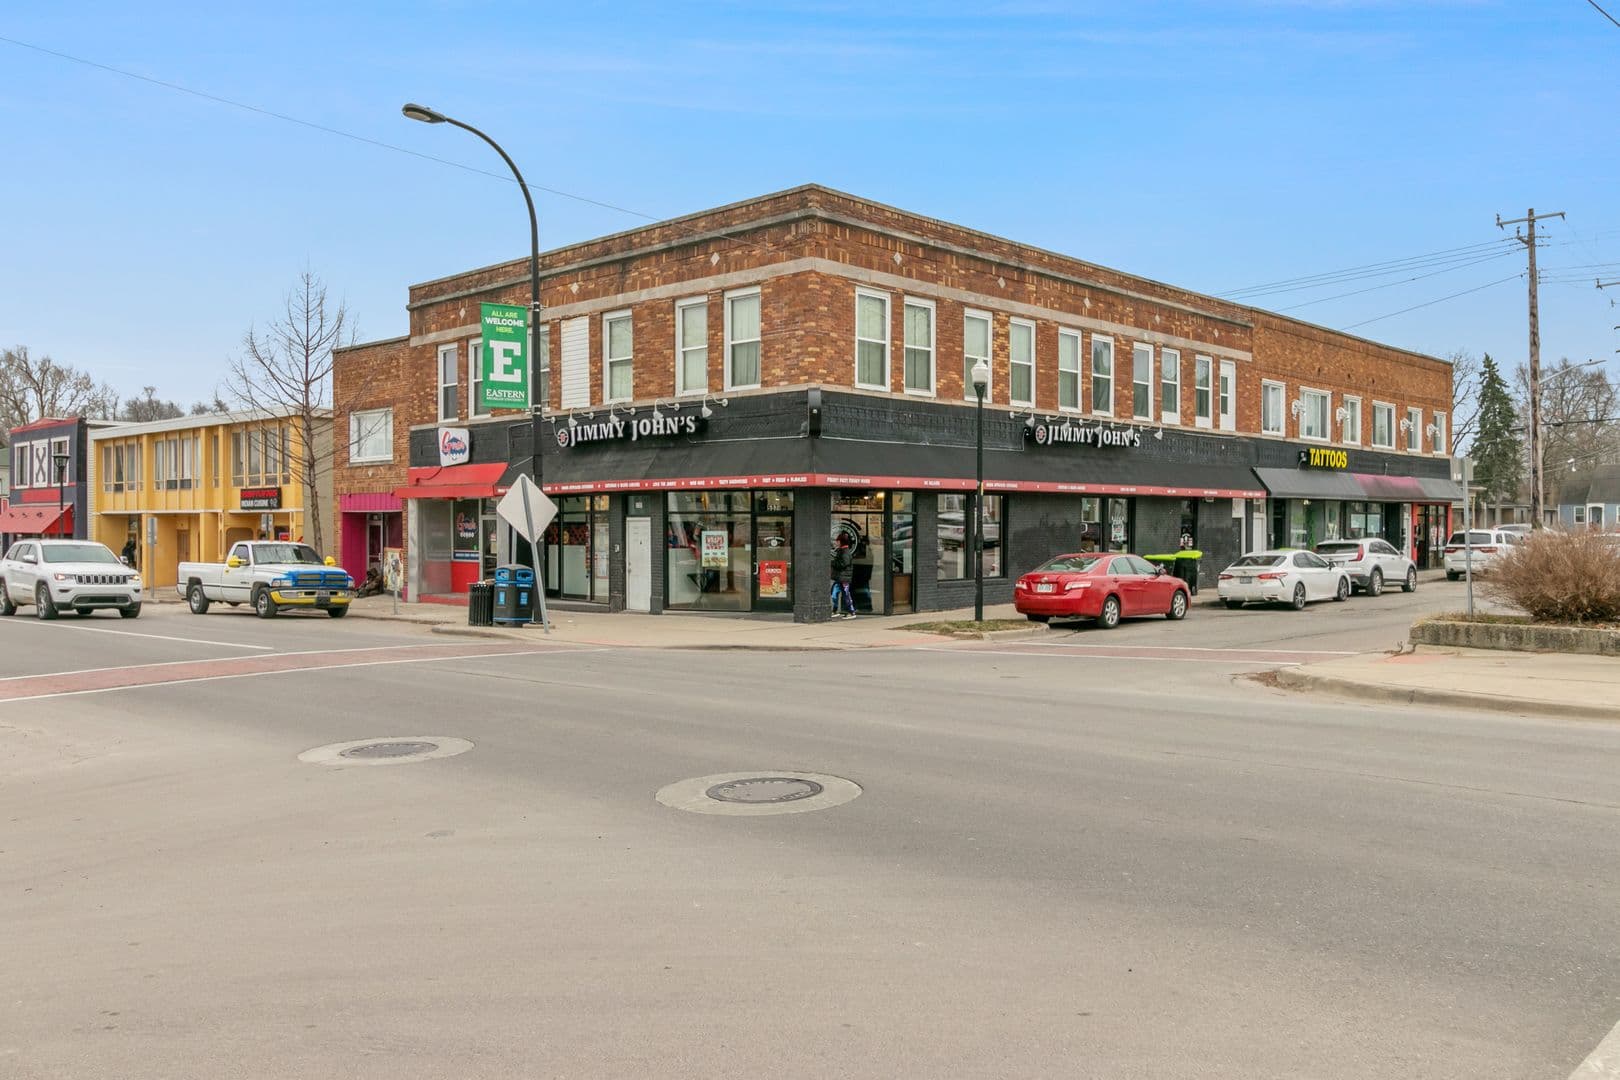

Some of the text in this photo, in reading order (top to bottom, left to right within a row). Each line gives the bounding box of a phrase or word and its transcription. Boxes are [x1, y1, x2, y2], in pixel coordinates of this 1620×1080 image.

[485, 317, 525, 327] WELCOME
[489, 340, 522, 383] E
[486, 388, 525, 399] EASTERN
[570, 415, 696, 447] JIMMY JOHN'S
[1047, 425, 1141, 448] JIMMY JOHN'S
[1310, 448, 1347, 468] TATTOOS
